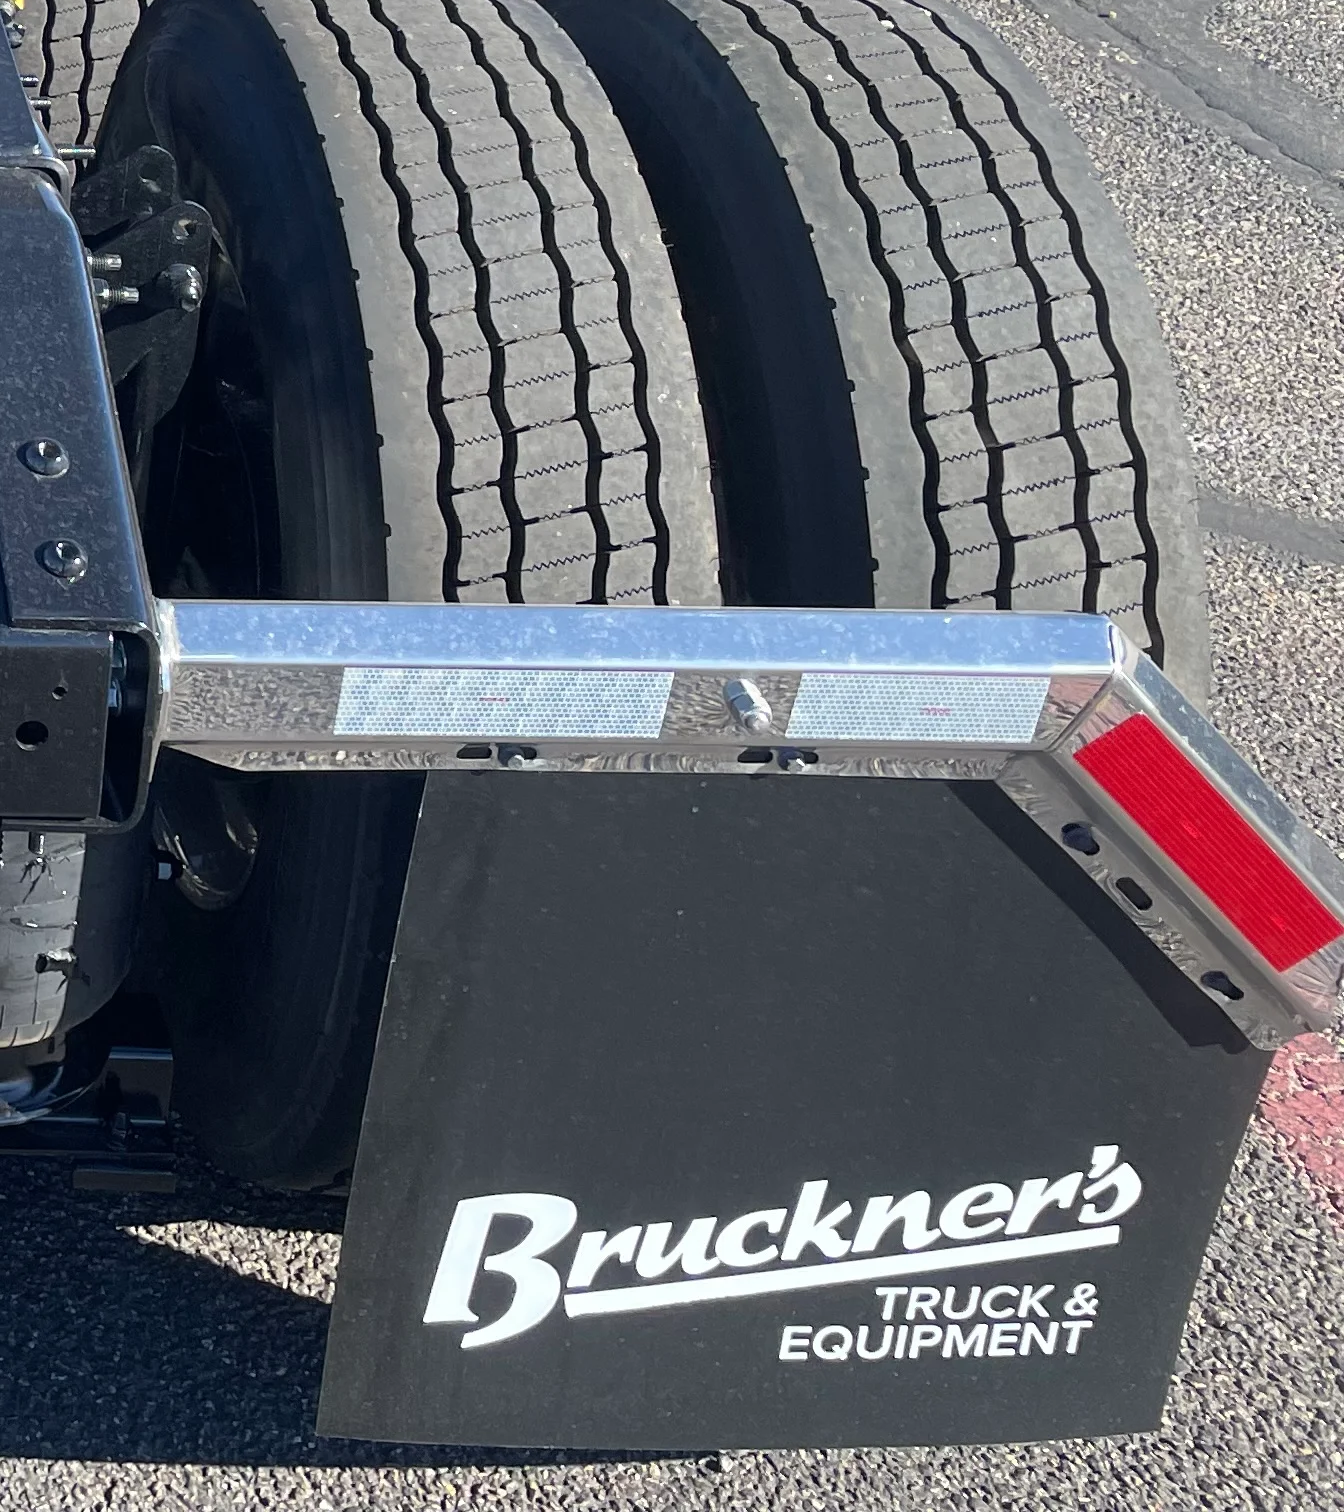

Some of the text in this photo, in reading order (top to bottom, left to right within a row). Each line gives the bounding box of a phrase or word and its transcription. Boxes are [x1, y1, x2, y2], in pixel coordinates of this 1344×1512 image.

[422, 1144, 1143, 1350] Bruckner's
[875, 1282, 1100, 1321] TRUCK &
[778, 1320, 1094, 1361] EQUIPMENT
